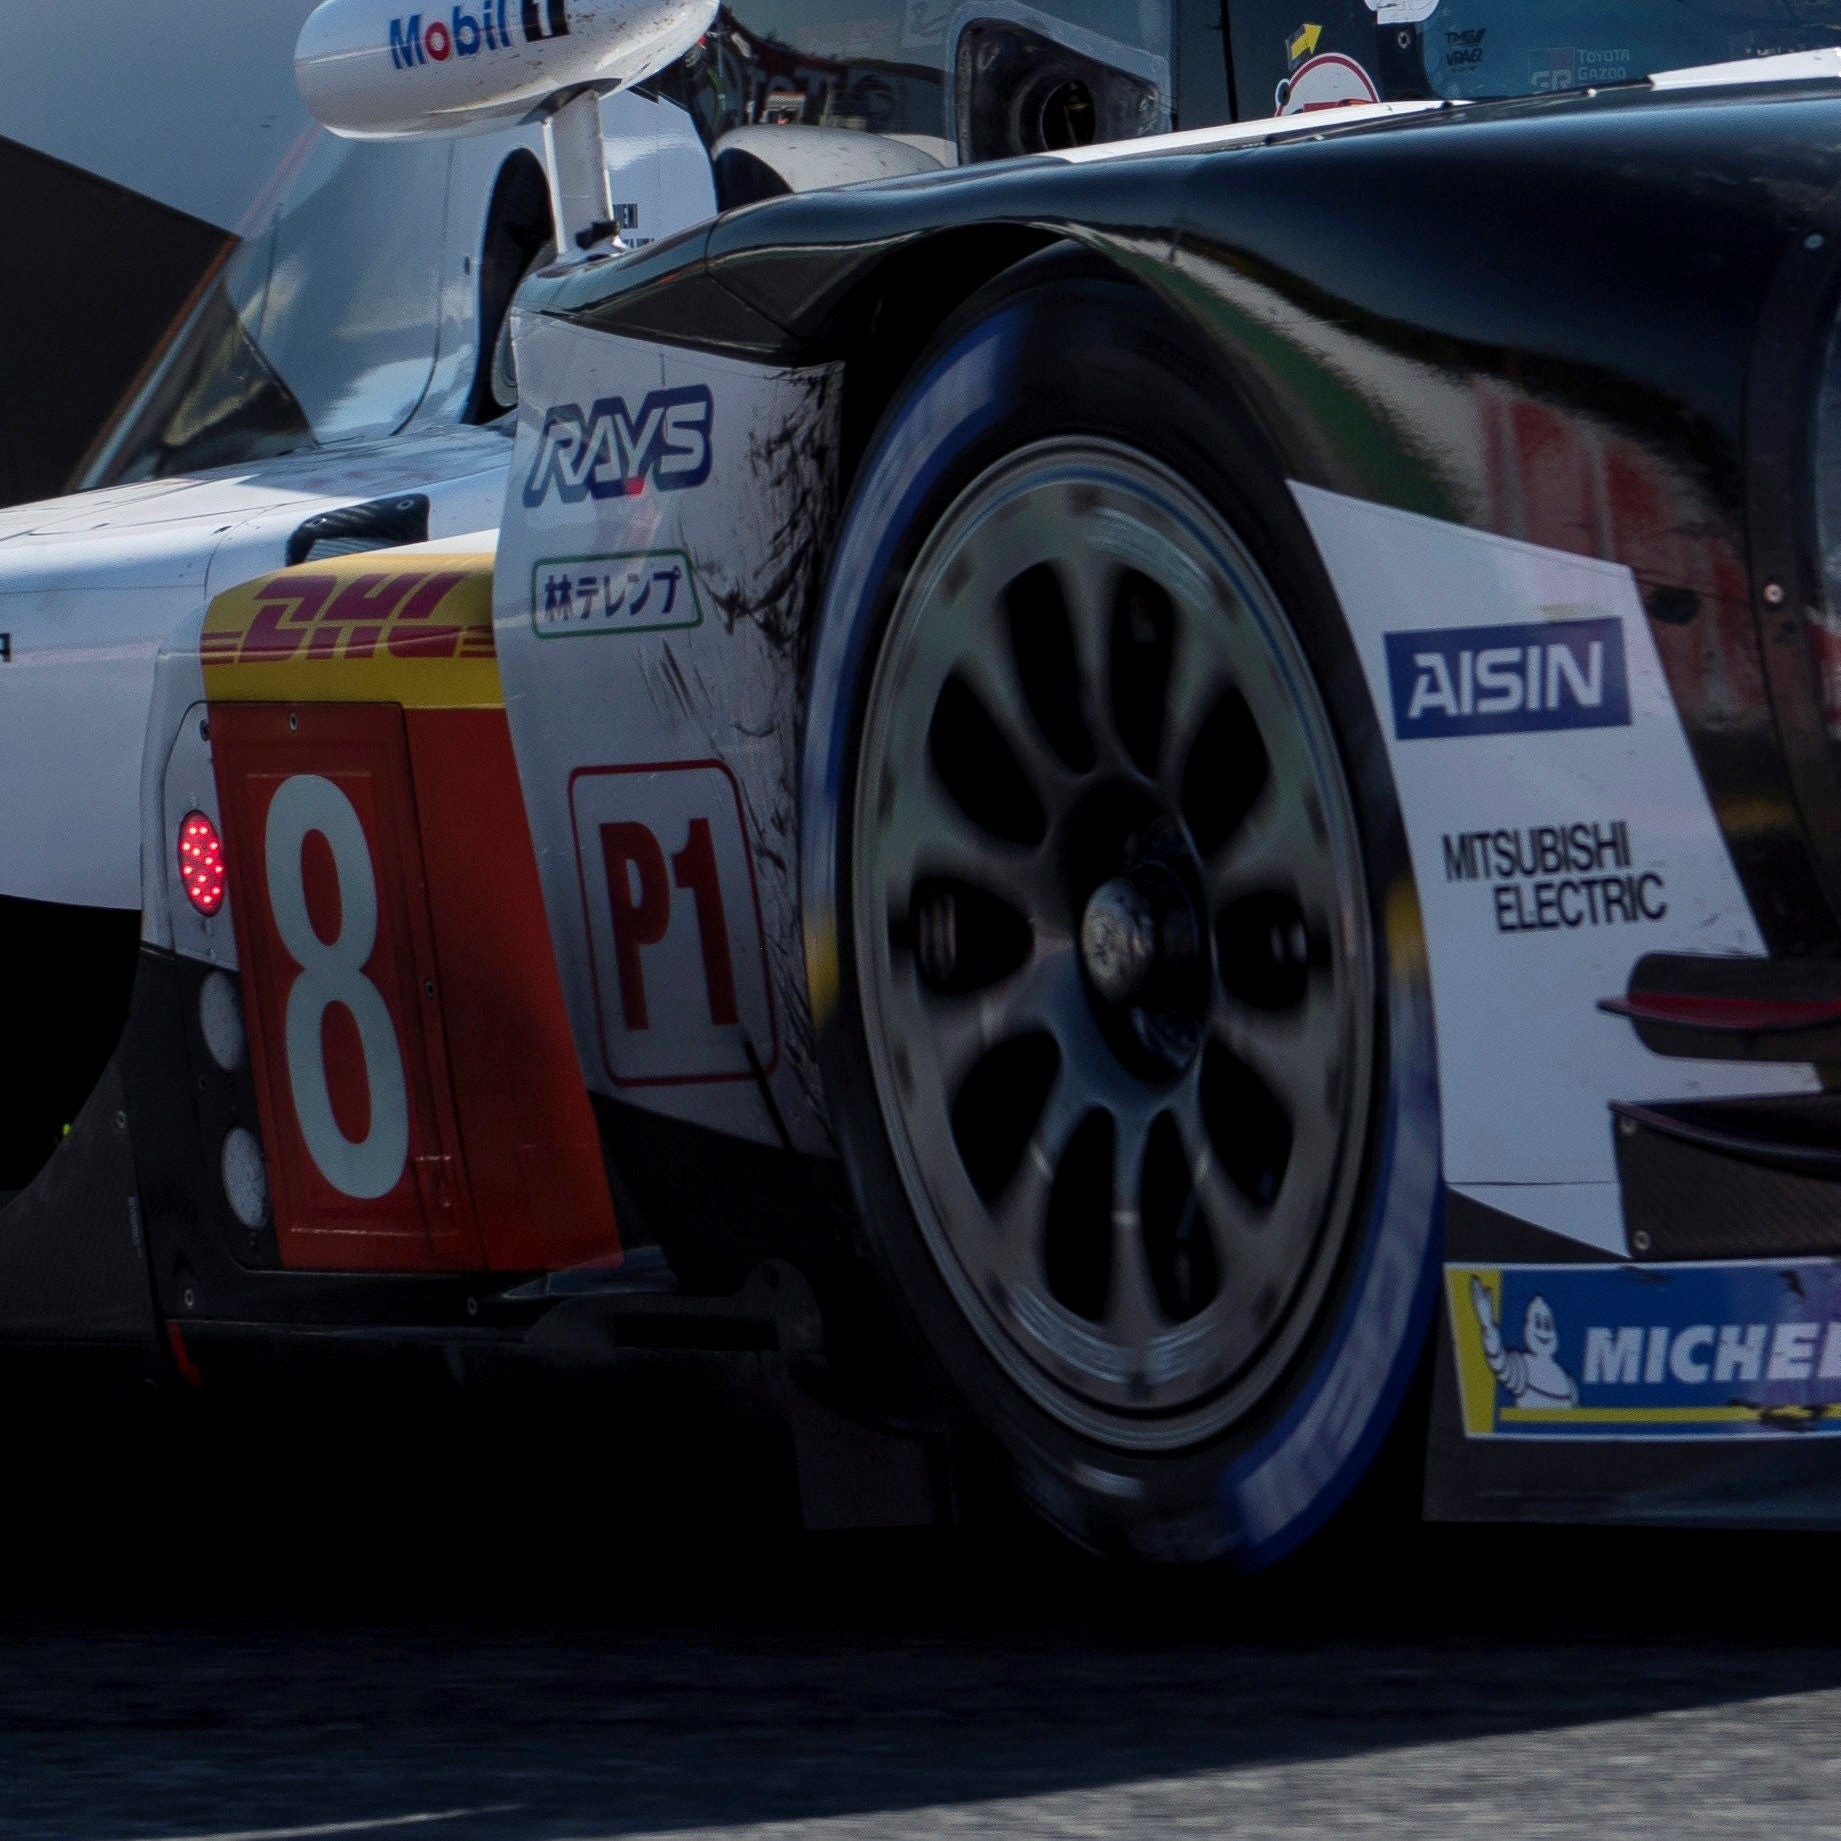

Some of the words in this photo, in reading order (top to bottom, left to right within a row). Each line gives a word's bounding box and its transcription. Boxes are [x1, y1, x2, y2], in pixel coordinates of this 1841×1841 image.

[1577, 49, 1630, 63] TOYOTA
[523, 384, 714, 507] RAYS
[238, 571, 470, 662] DHL
[1408, 640, 1605, 719] AISIN
[1442, 820, 1632, 882] MITSUBISHI
[600, 817, 738, 1031] P1
[1493, 872, 1669, 935] ELECTRIC
[264, 773, 410, 1201] 8
